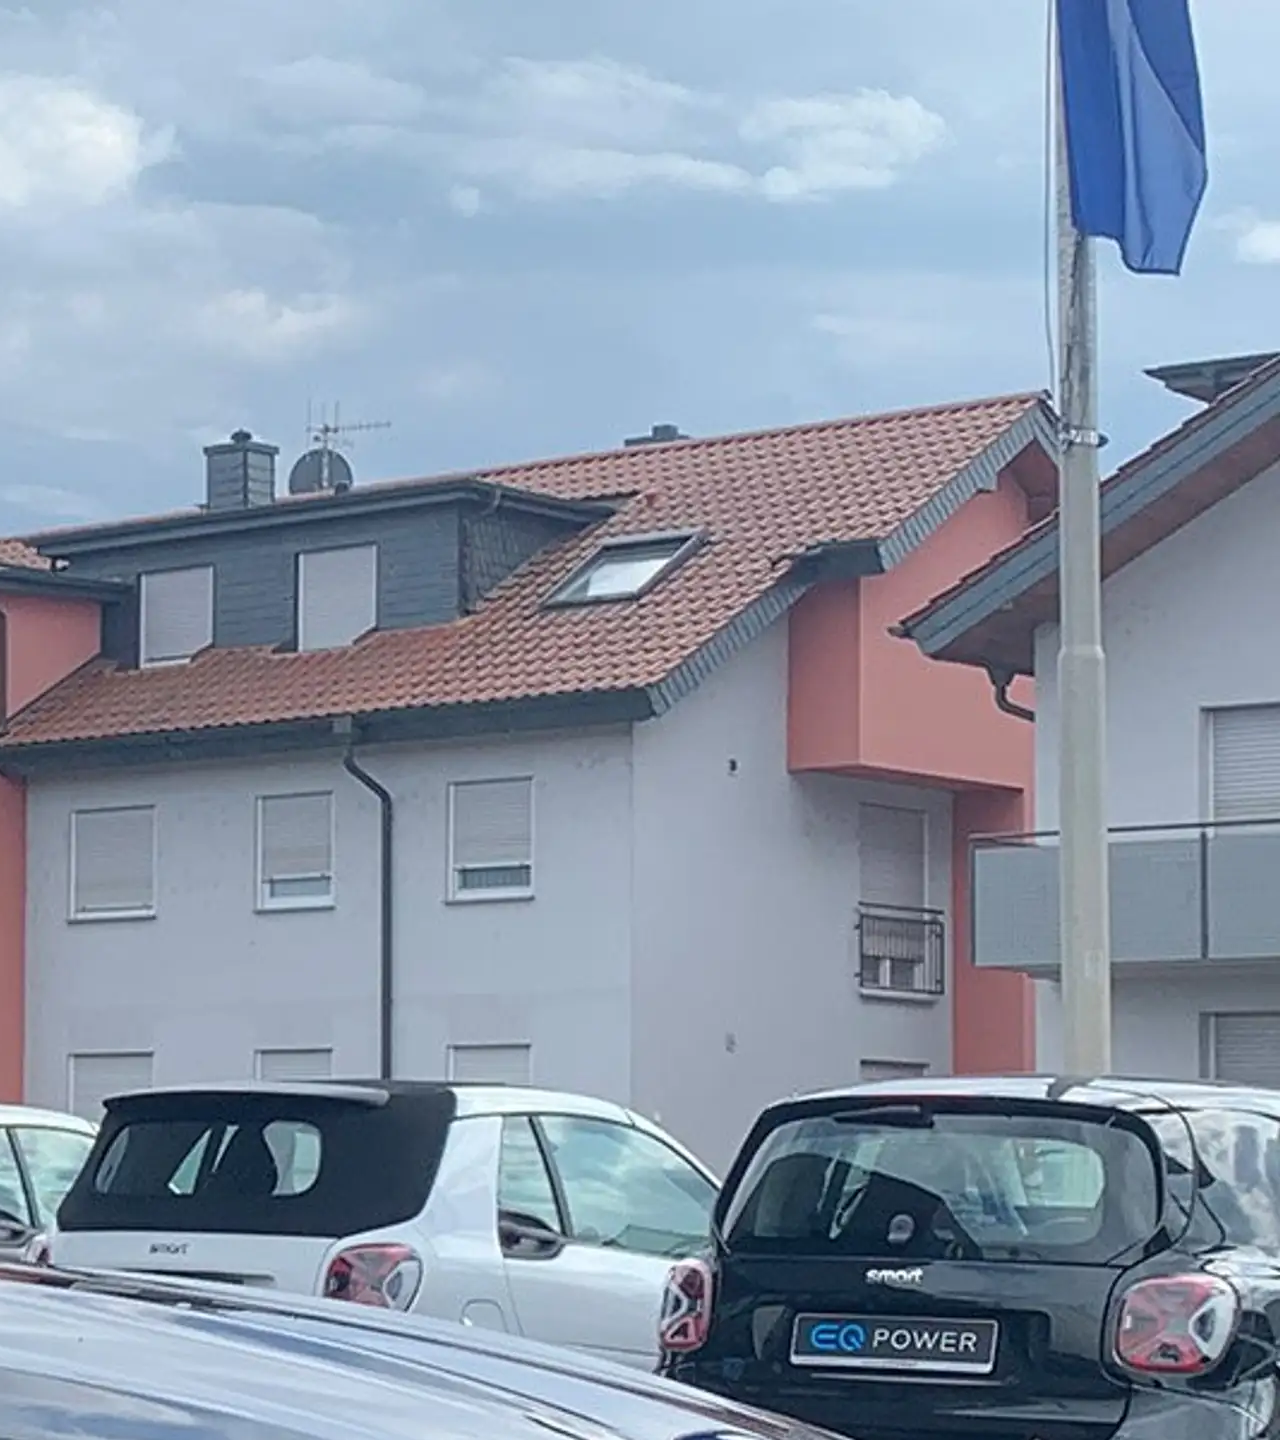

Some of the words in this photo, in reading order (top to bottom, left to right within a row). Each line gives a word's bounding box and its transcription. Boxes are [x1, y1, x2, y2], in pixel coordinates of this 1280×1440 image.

[865, 1267, 924, 1284] smart
[811, 1323, 865, 1350] EQ
[872, 1328, 978, 1353] POWER
